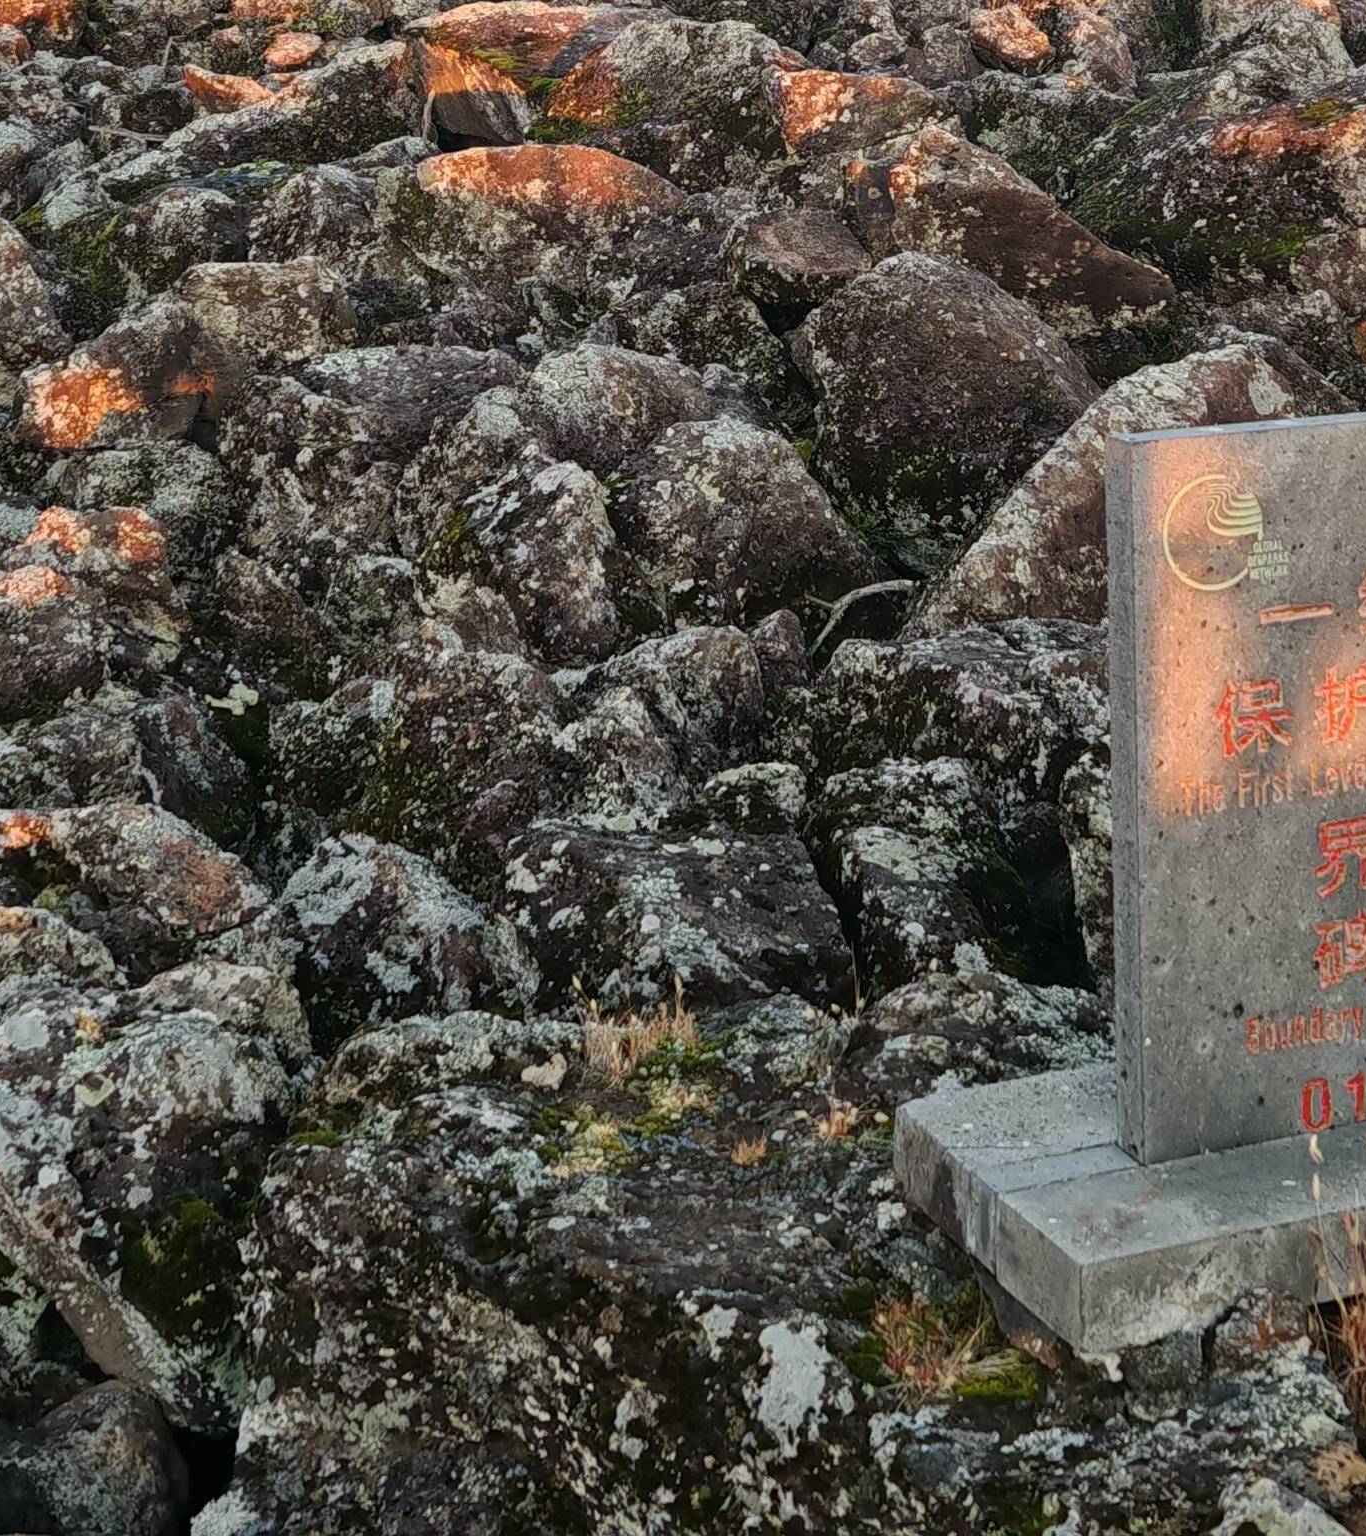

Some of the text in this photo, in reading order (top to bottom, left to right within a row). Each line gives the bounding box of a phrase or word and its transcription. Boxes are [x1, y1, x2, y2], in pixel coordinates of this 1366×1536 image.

[1178, 776, 1226, 817] The
[1238, 764, 1294, 808] First
[1246, 1006, 1364, 1054] Boundary
